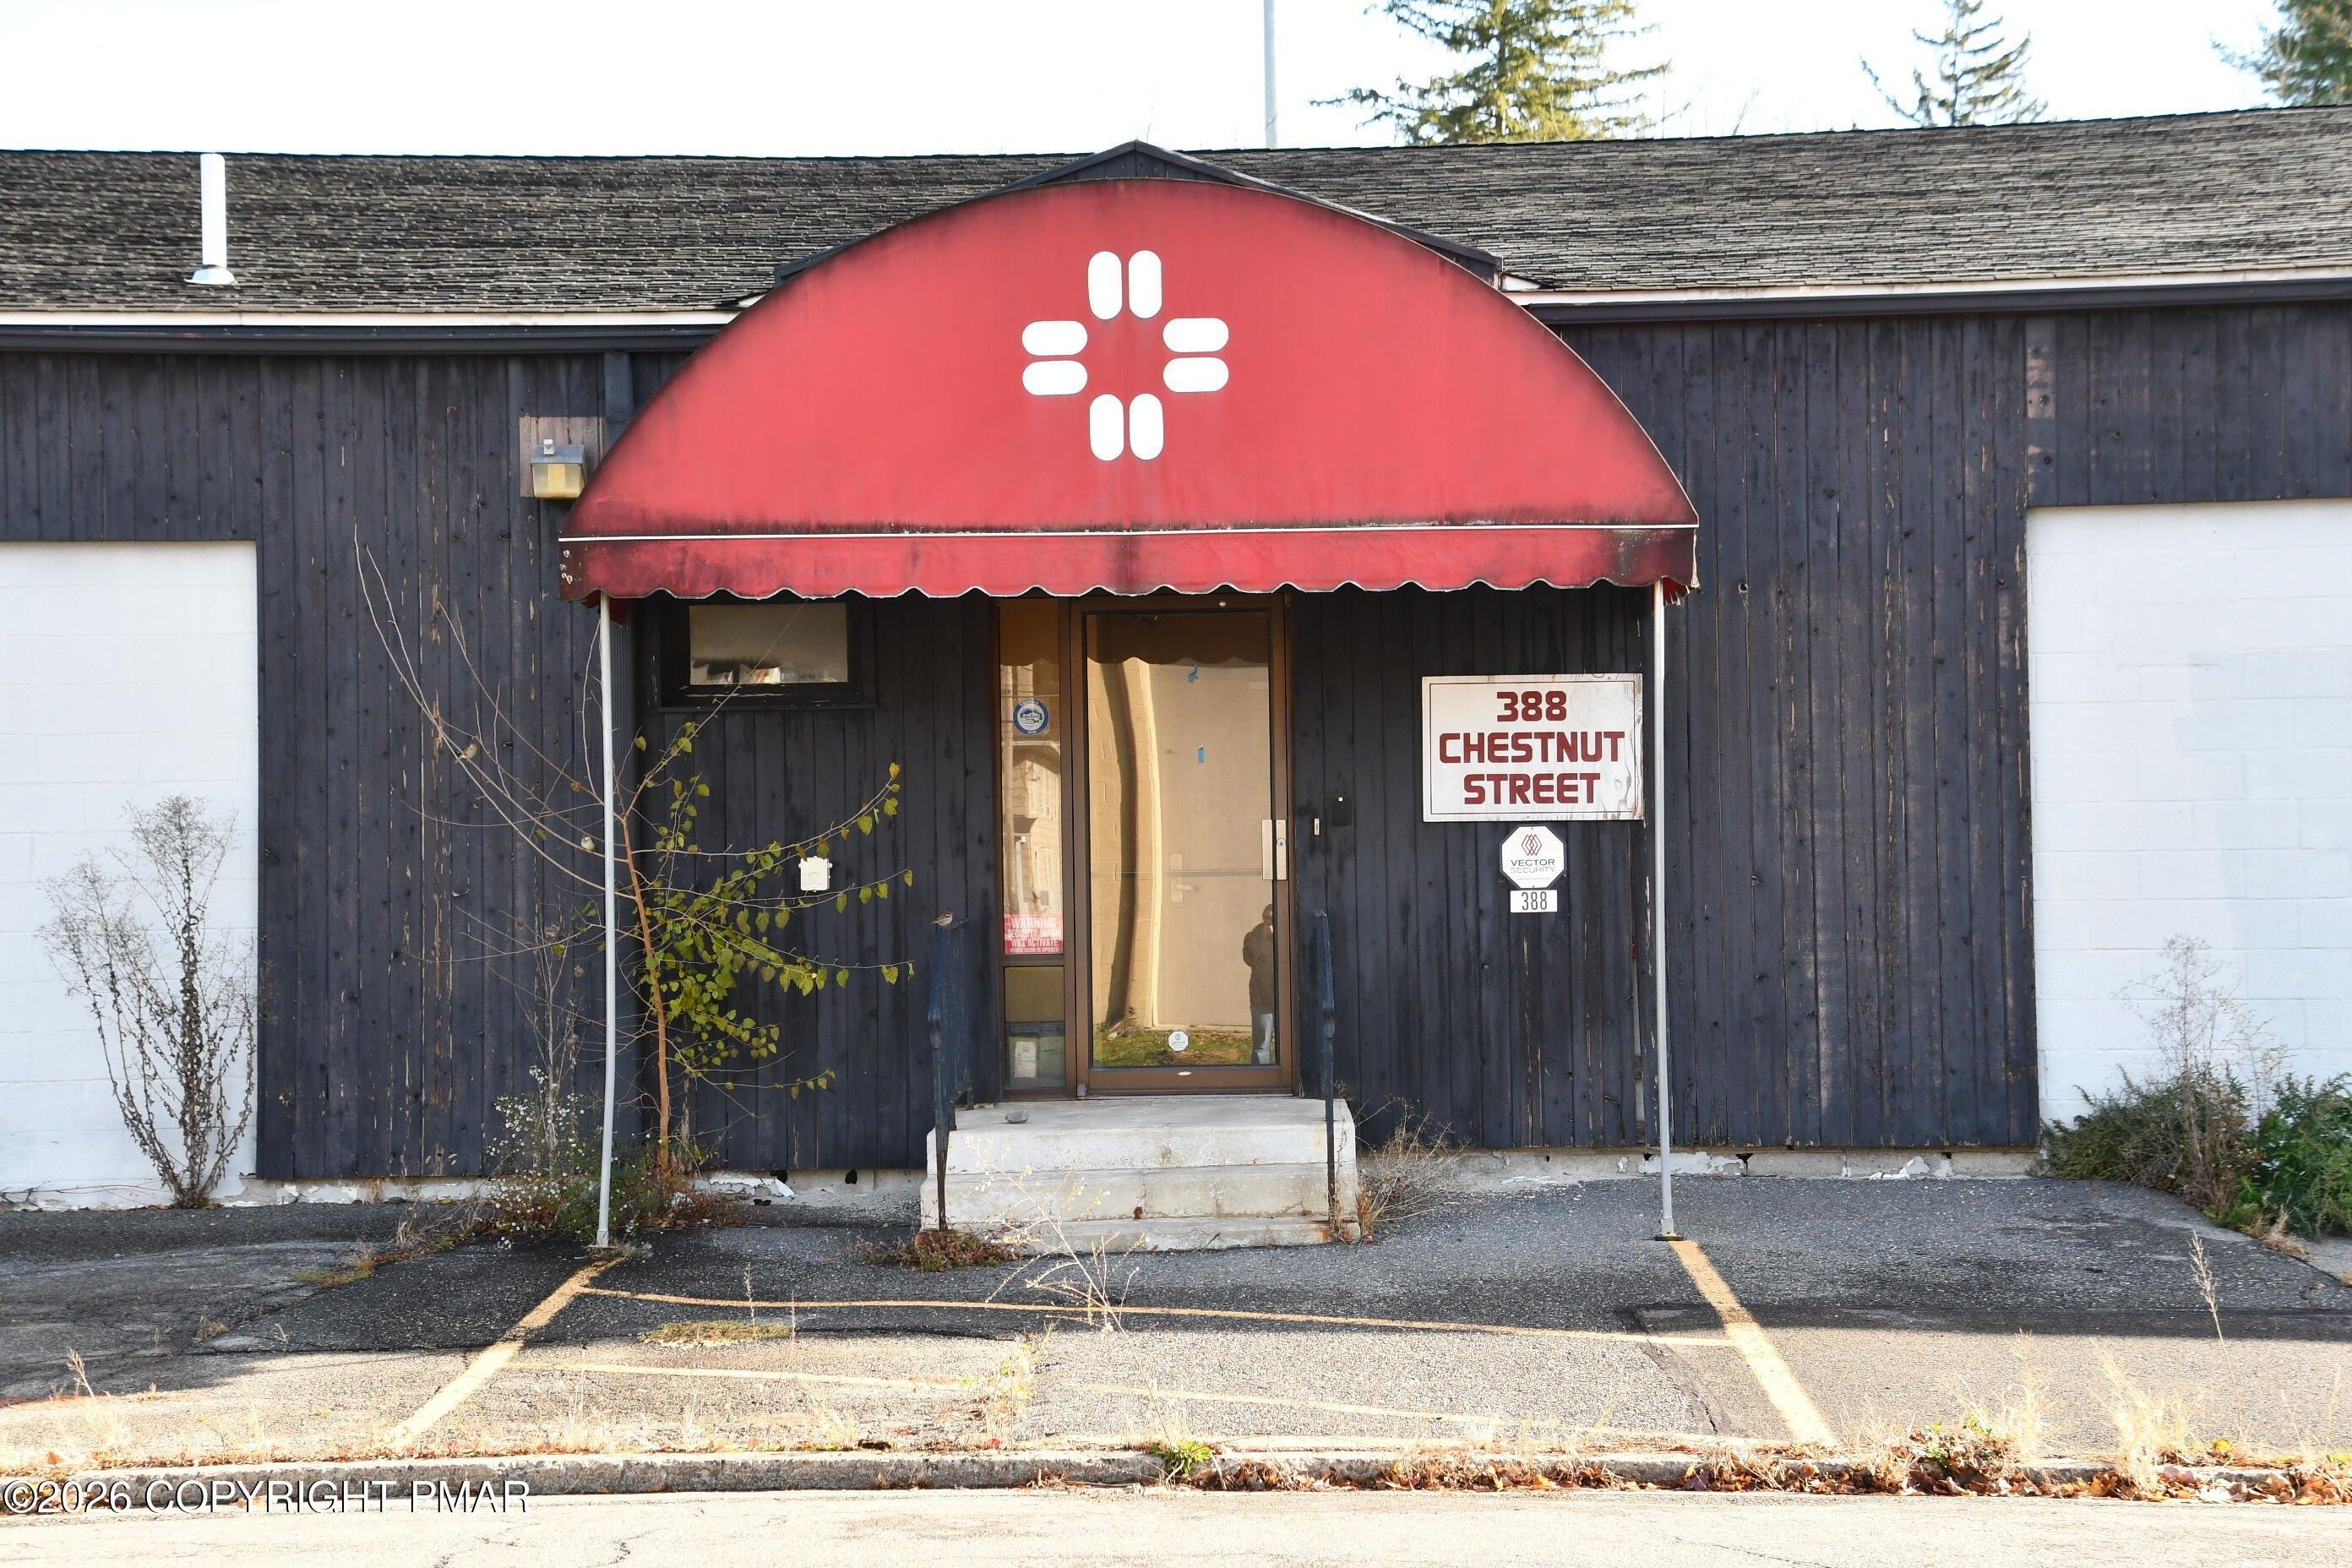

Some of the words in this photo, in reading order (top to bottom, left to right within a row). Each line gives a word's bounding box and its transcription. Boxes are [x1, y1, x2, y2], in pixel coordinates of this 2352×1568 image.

[1496, 690, 1567, 722] 388
[1439, 731, 1625, 764] CHESTNUT
[1463, 772, 1601, 805] STREET
[1511, 858, 1555, 867] VECTOR
[1521, 890, 1548, 911] 388
[1027, 938, 1059, 946] ACTIVATE
